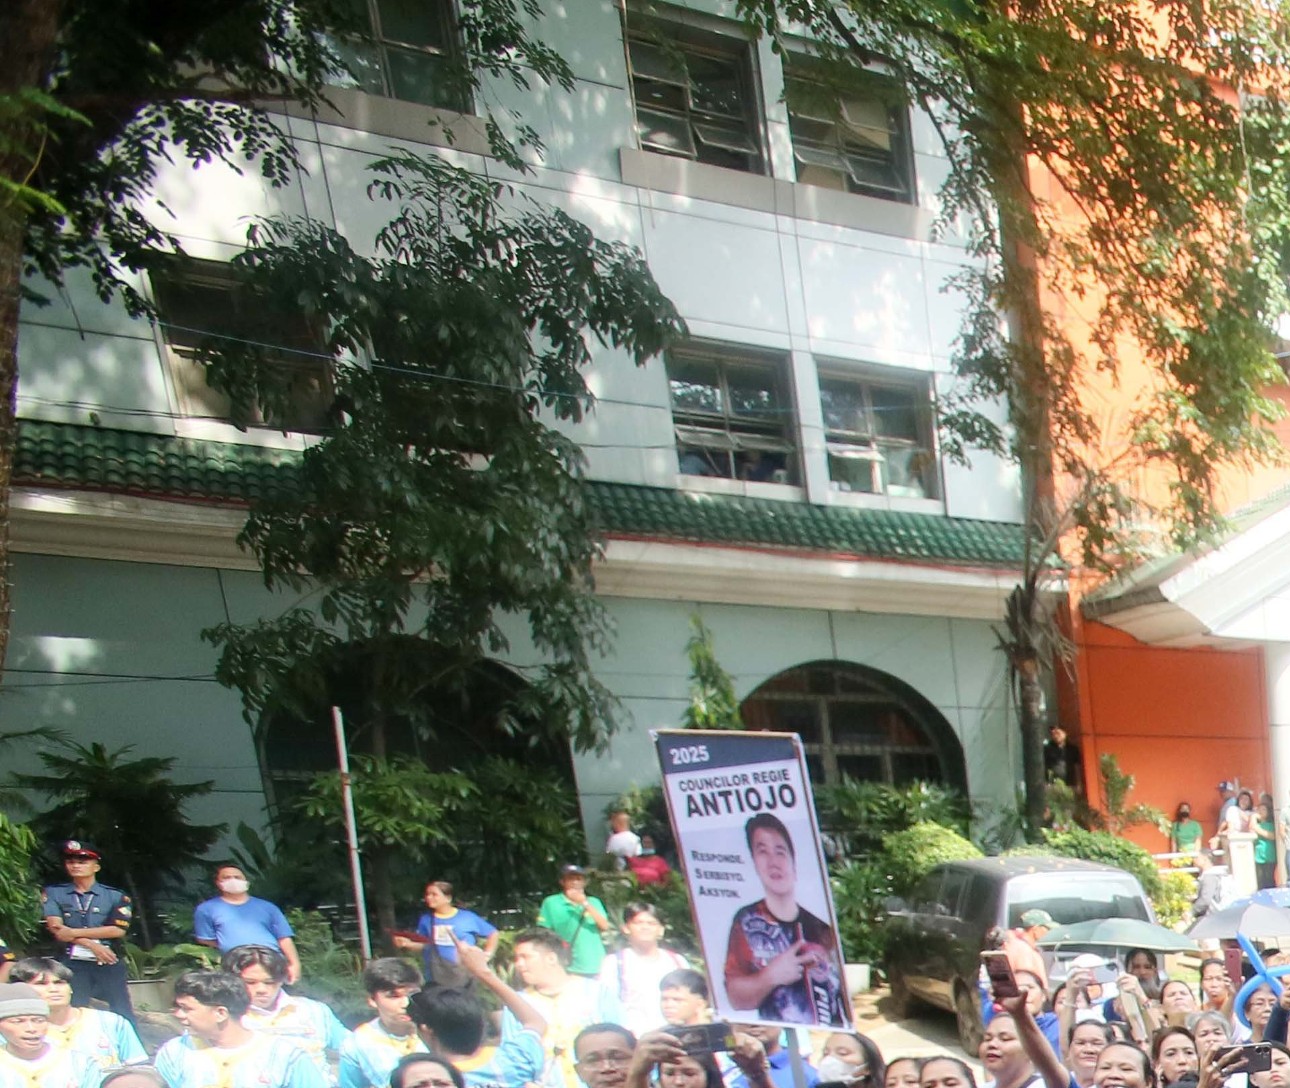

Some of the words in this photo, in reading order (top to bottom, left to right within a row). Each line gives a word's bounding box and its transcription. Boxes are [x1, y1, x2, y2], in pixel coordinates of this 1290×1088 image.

[669, 745, 710, 765] 2025
[679, 773, 751, 793] COUNCILOR
[753, 768, 791, 785] REGIE
[686, 783, 797, 818] ANTIOJO
[691, 850, 745, 865] RESPONDE.
